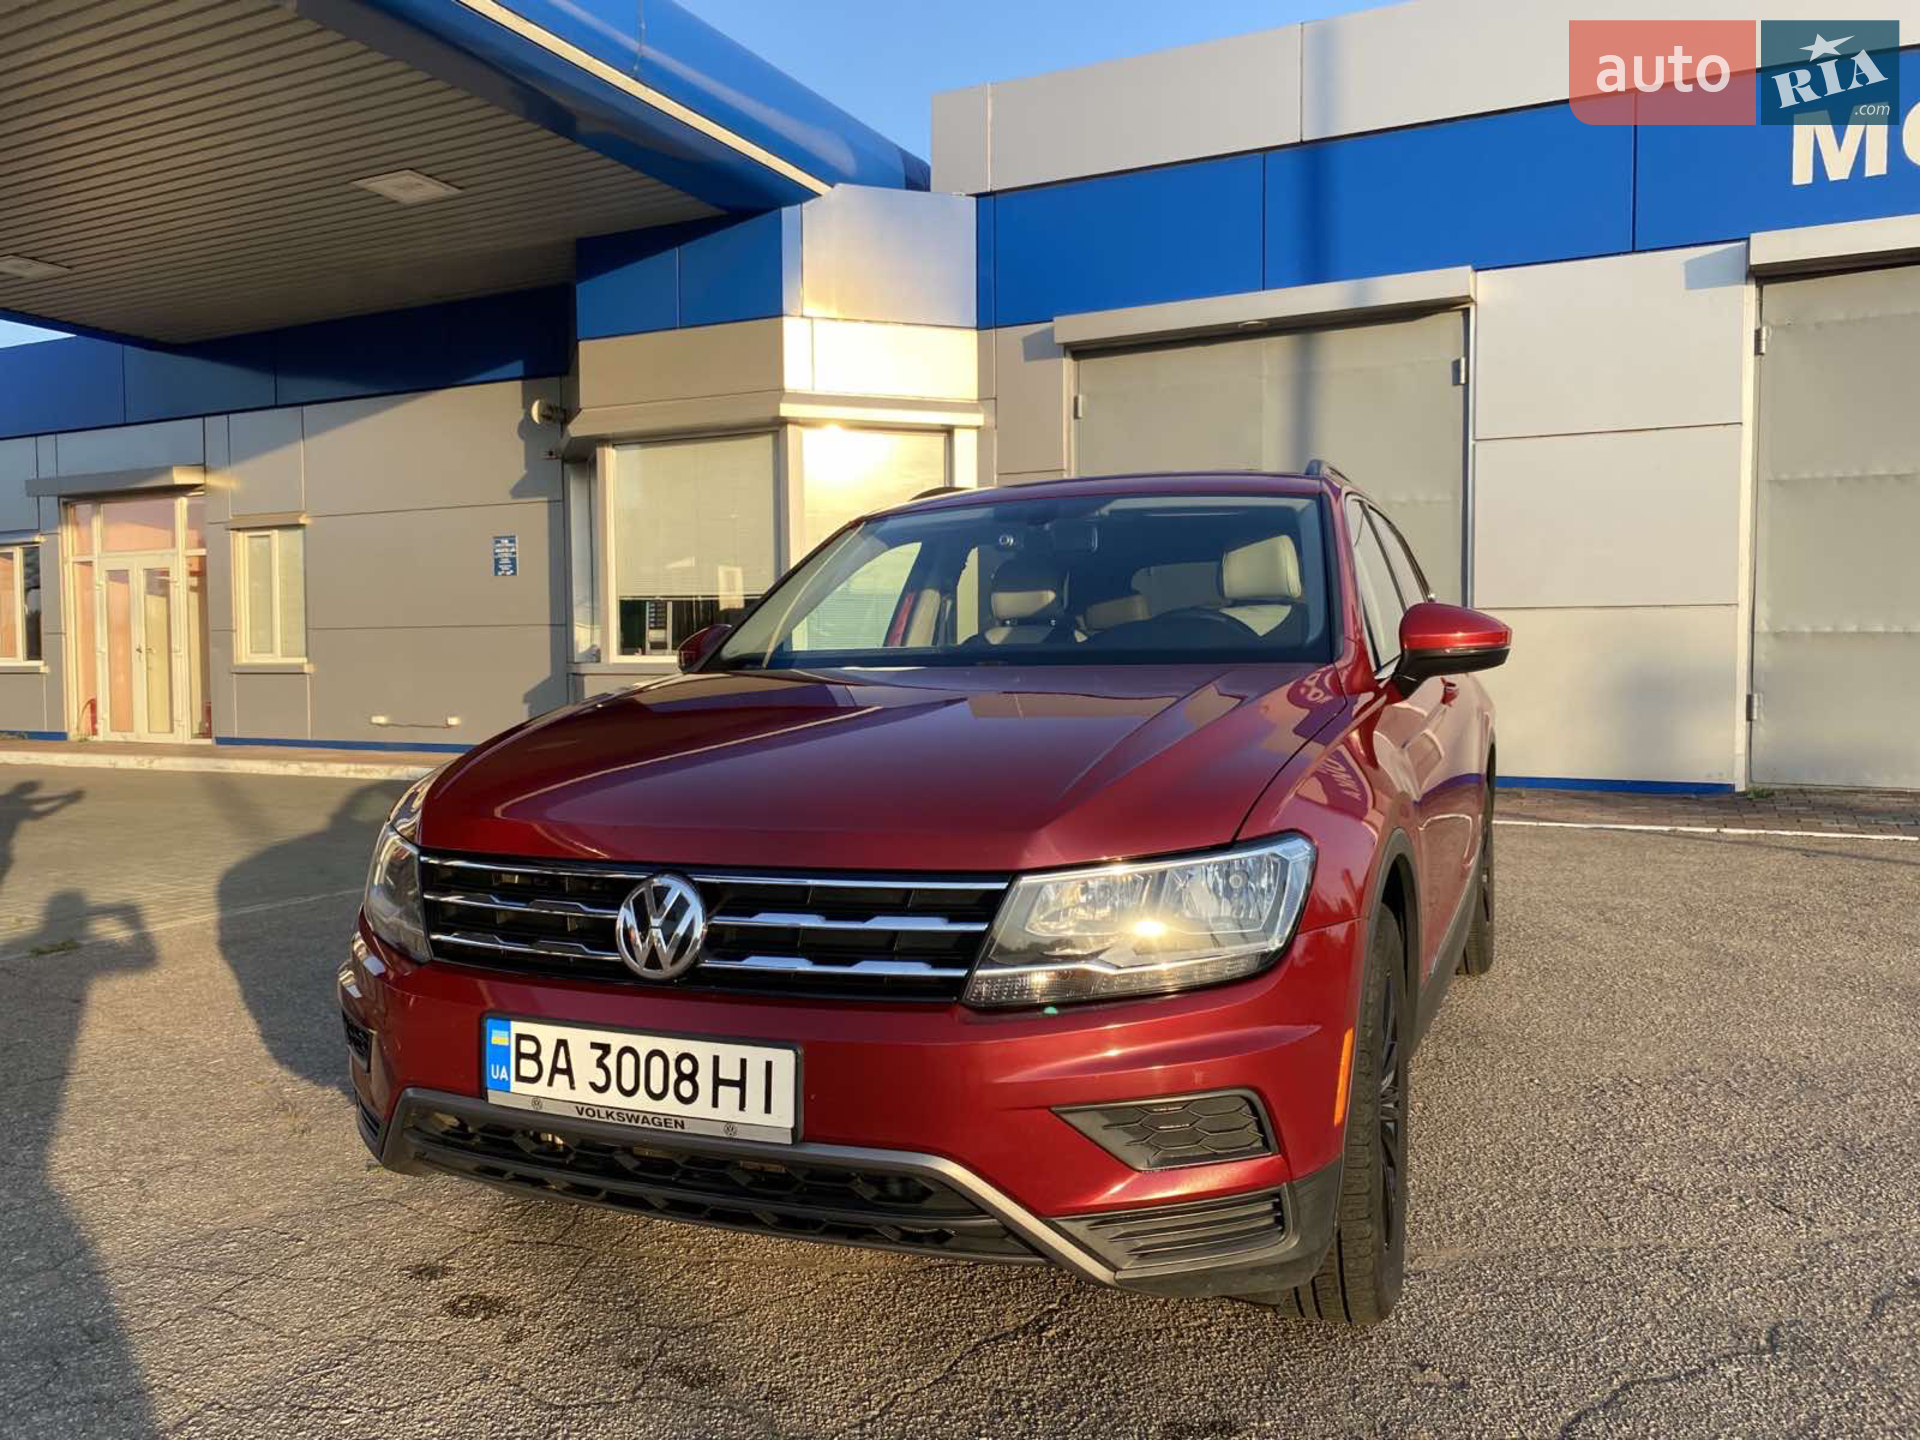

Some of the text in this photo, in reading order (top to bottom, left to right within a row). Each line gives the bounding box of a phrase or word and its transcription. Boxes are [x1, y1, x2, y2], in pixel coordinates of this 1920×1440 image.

[491, 1064, 509, 1081] UA
[514, 1033, 773, 1114] BA 3008 HI
[575, 1105, 686, 1130] VOLKSWAGEN
